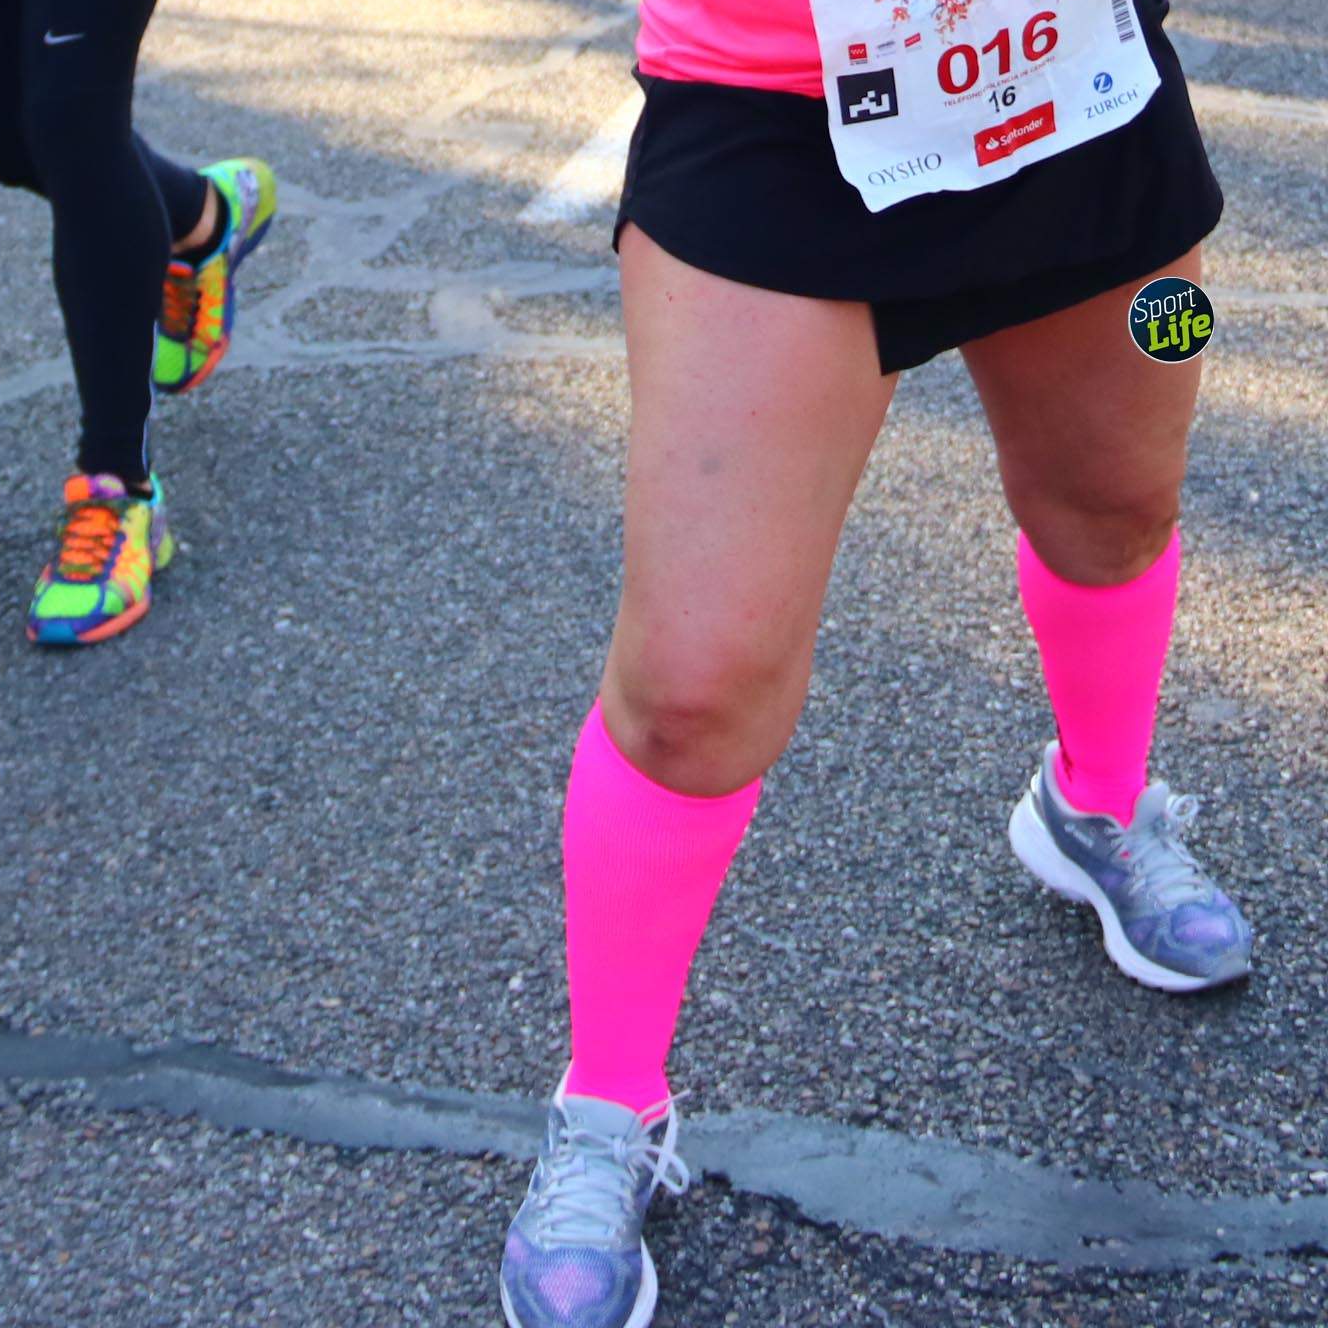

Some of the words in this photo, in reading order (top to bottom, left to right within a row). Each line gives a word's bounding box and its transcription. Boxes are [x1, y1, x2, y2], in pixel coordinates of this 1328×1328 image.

[936, 9, 1059, 96] 016
[988, 85, 1017, 113] 16
[1084, 88, 1139, 121] ZURICH
[866, 152, 943, 187] OYSHO
